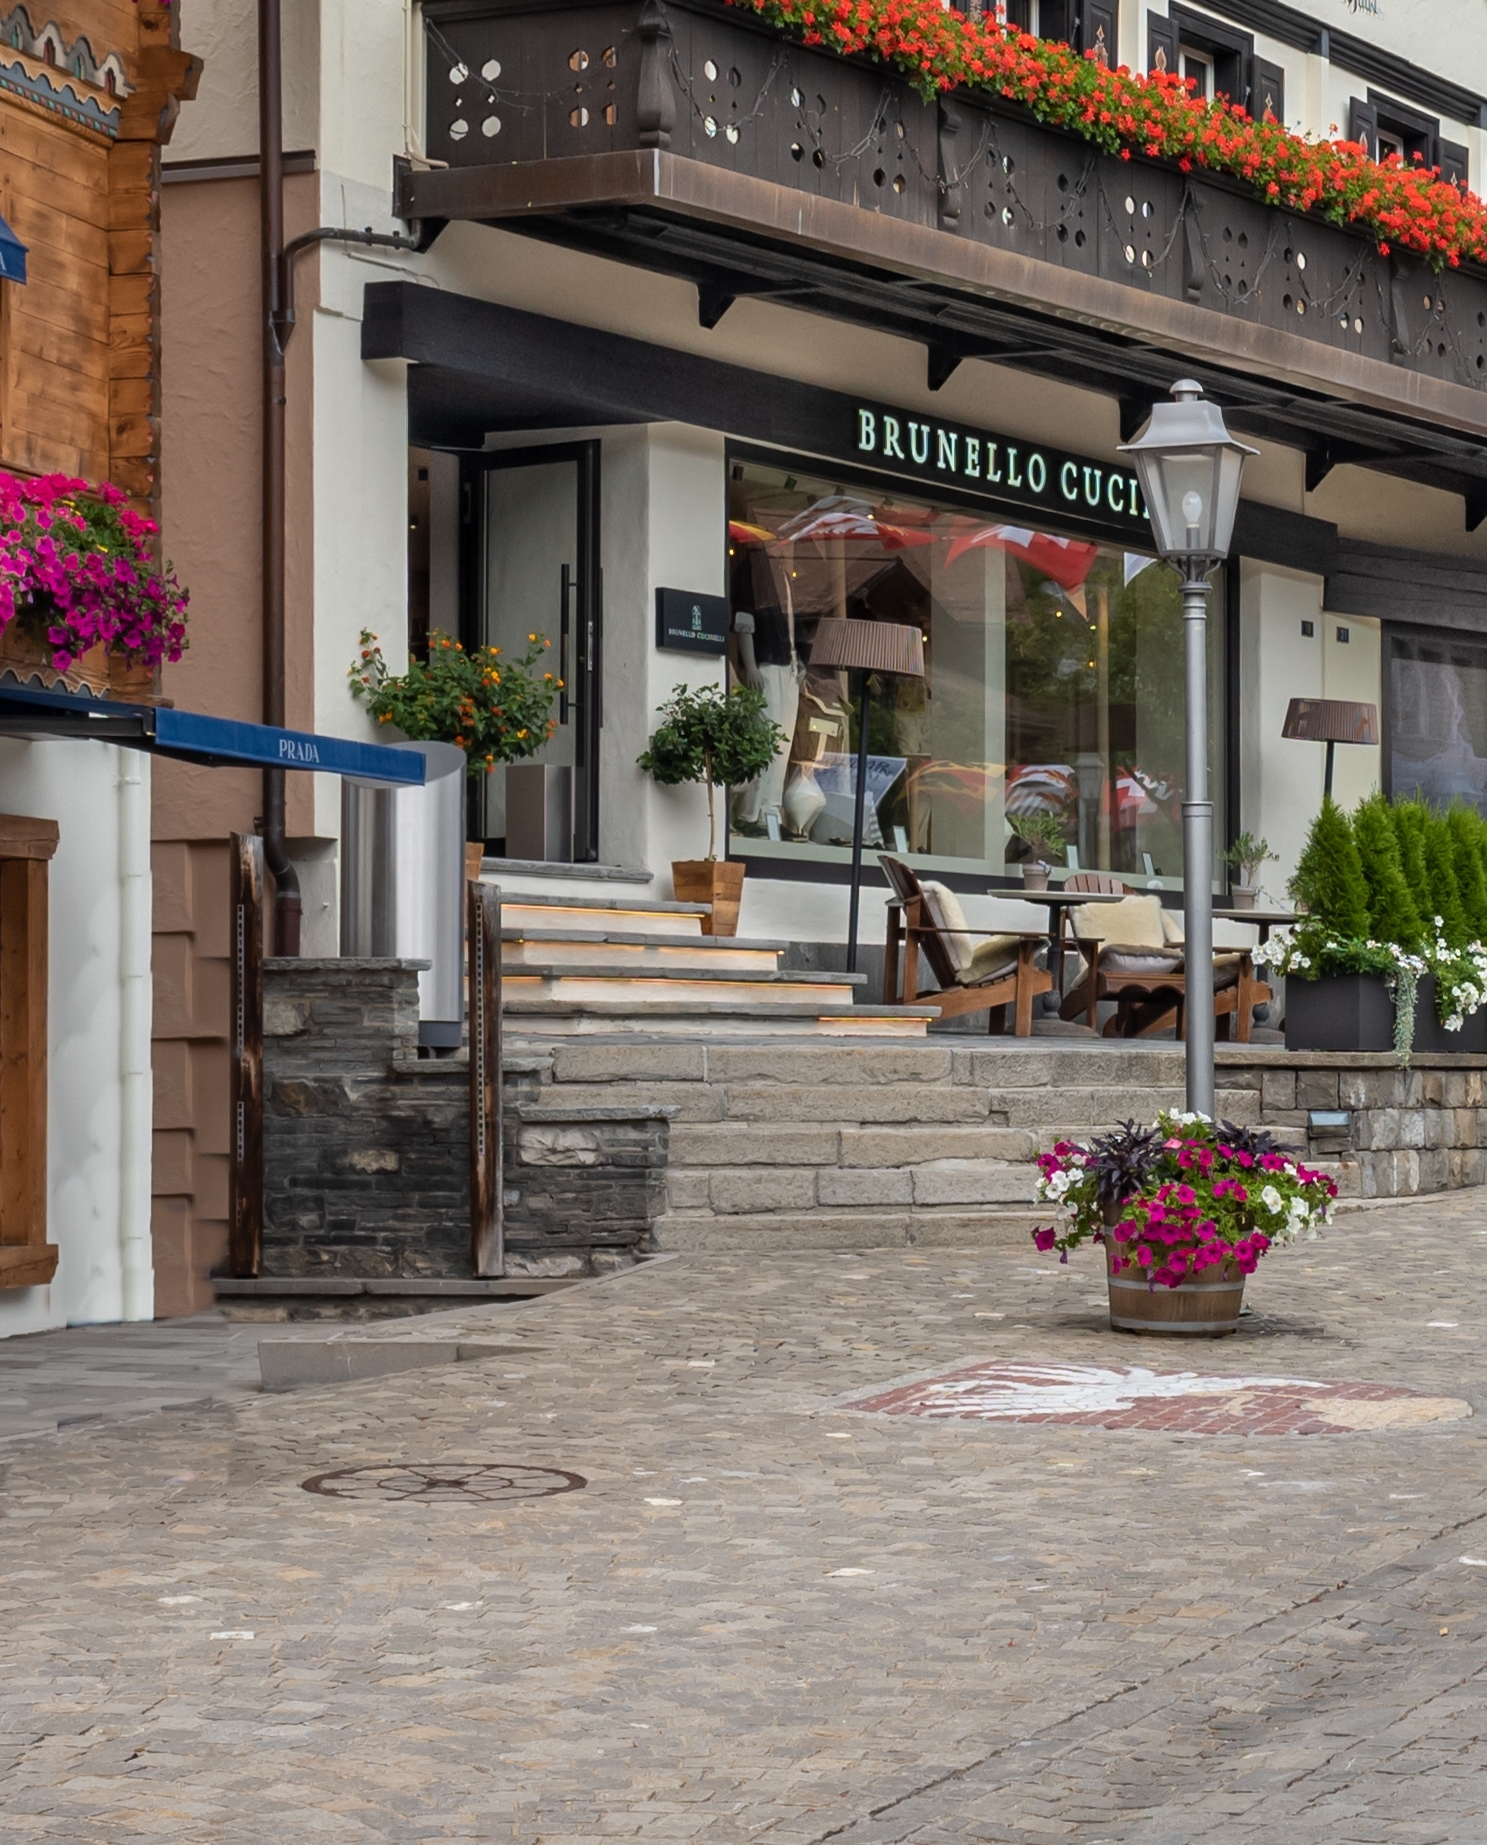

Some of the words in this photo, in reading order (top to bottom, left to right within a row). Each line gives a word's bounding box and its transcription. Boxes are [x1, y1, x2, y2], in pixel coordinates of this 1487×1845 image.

[858, 409, 1046, 493] BRUNELLO
[1060, 461, 1151, 519] CUCI
[277, 738, 320, 765] PRADA
